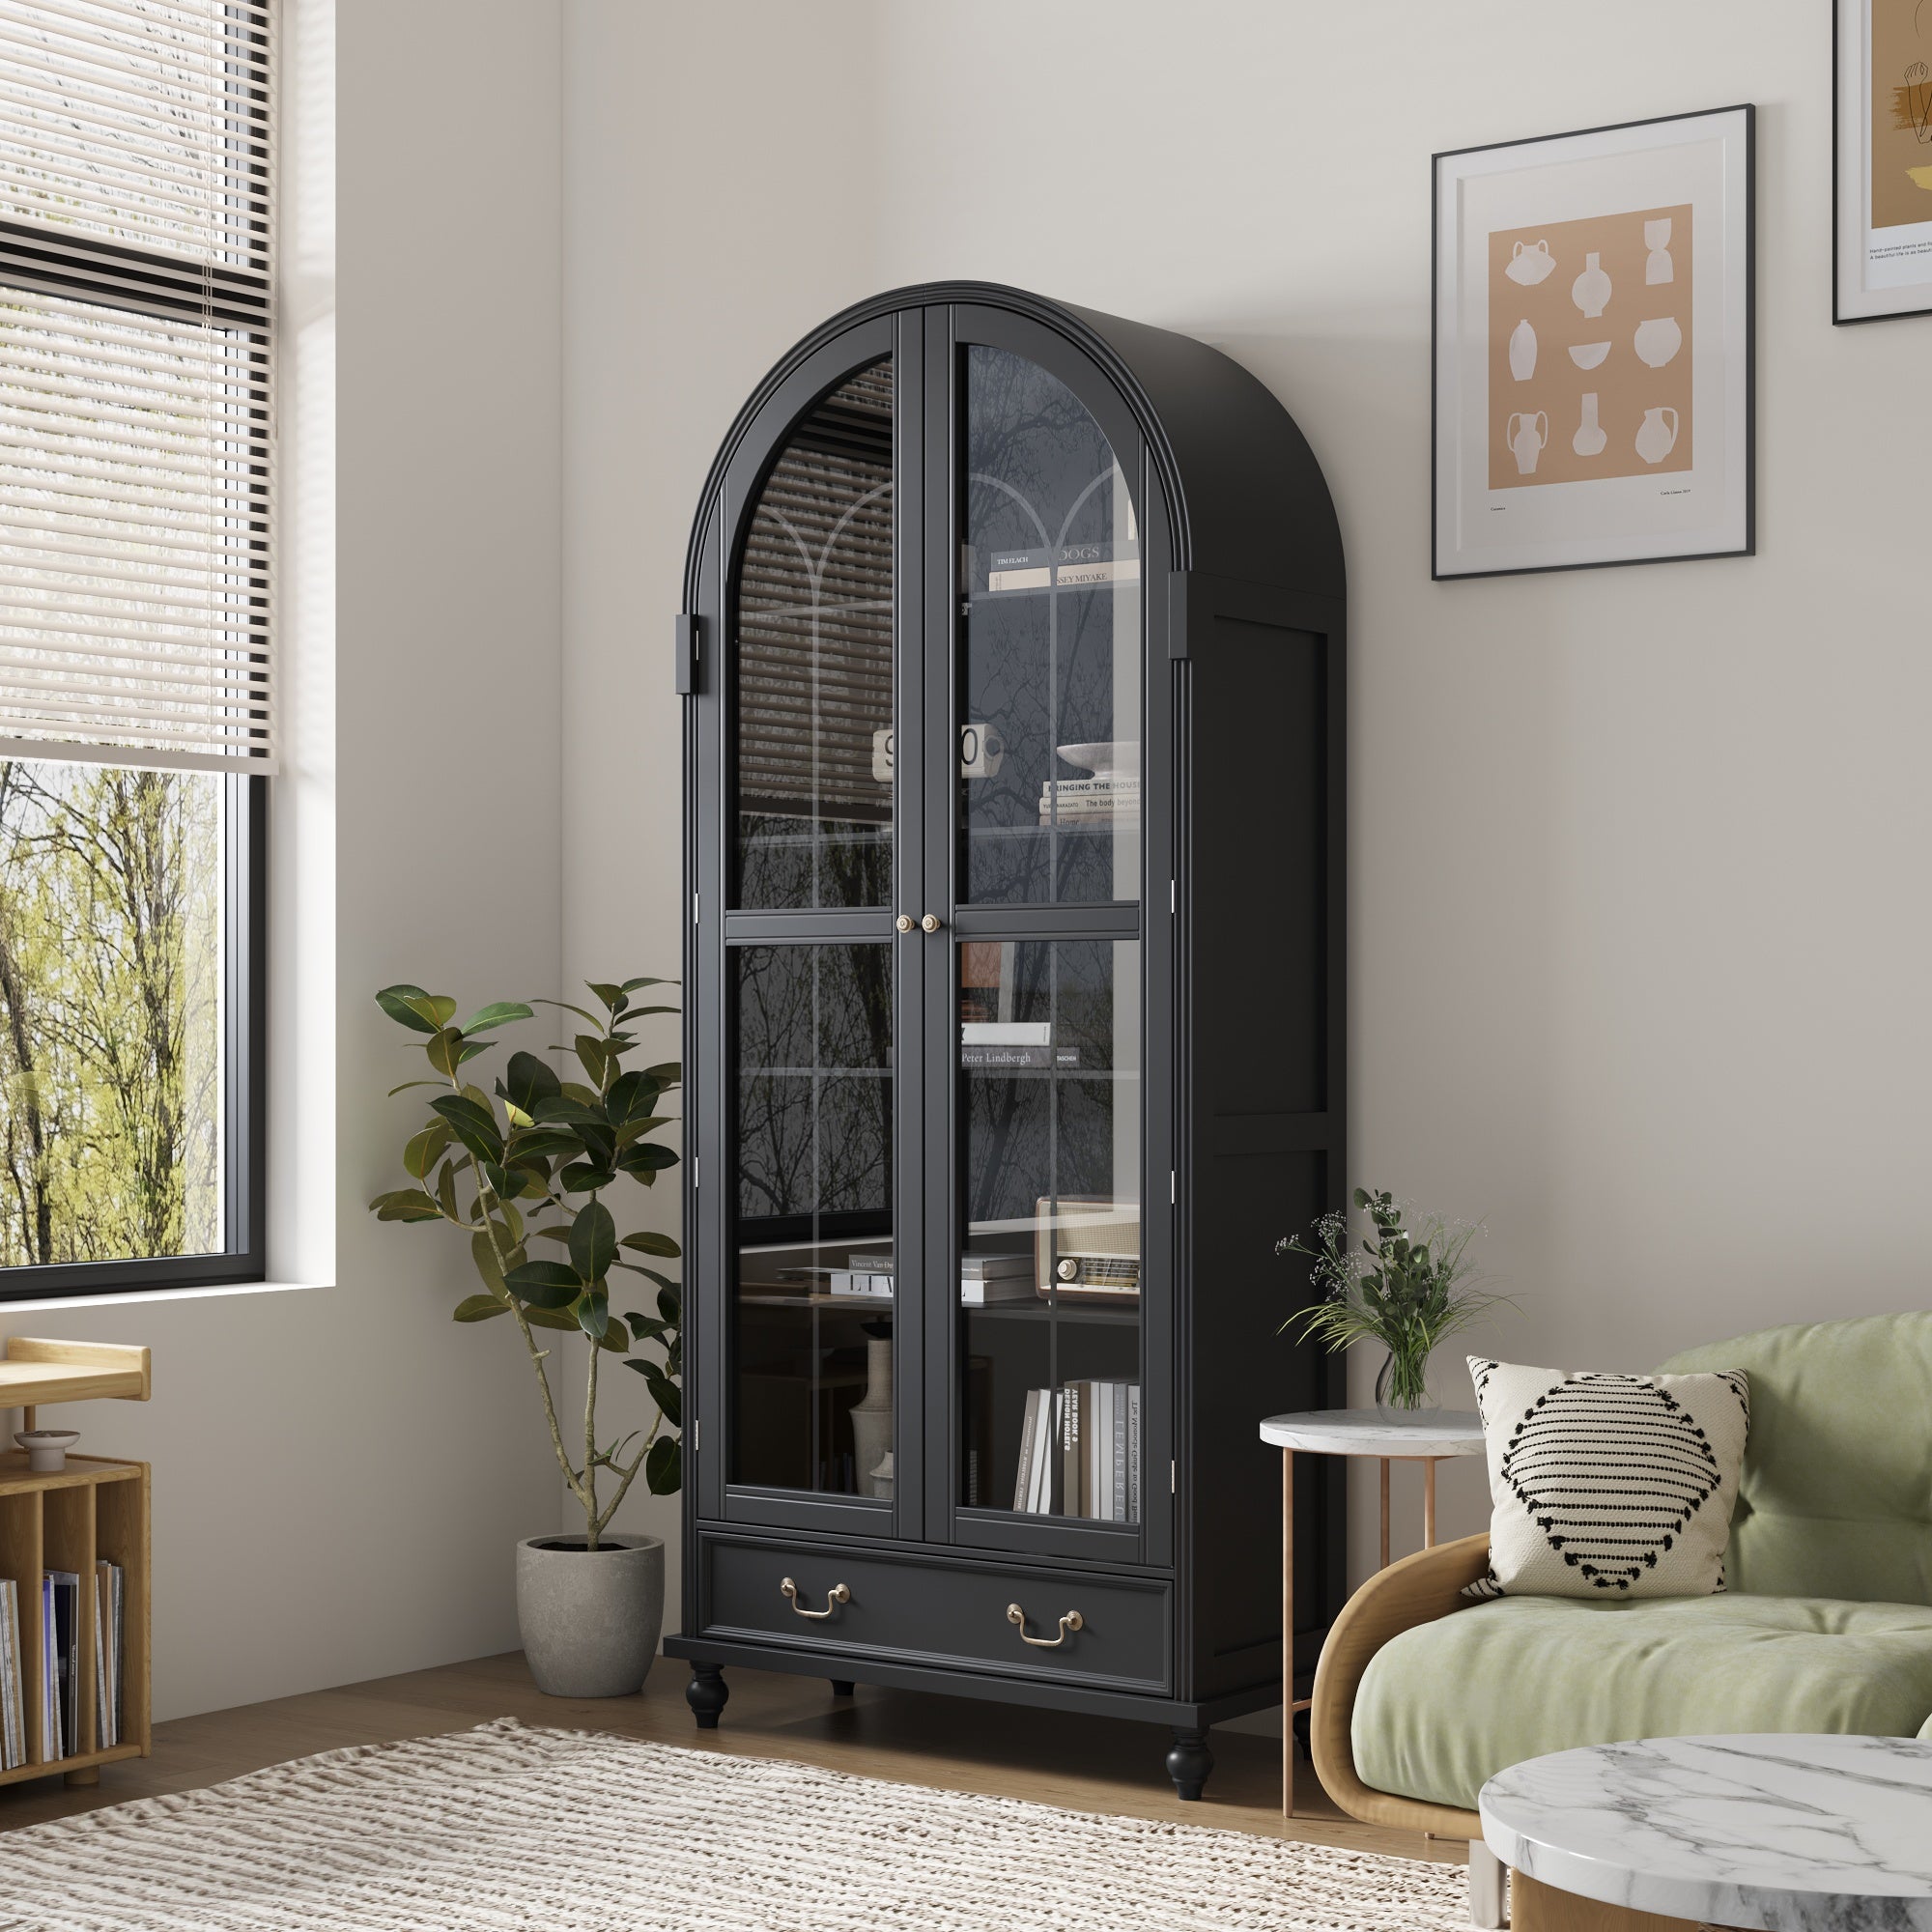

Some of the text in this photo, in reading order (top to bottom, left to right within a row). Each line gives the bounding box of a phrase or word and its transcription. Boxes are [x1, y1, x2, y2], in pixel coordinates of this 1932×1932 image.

[1058, 547, 1099, 561] DOGS
[1075, 572, 1107, 582] MIYAKE
[961, 727, 978, 766] 0
[1099, 799, 1115, 809] body
[961, 1052, 1031, 1065] Peter Lindbergh
[851, 1259, 872, 1268] Vincent
